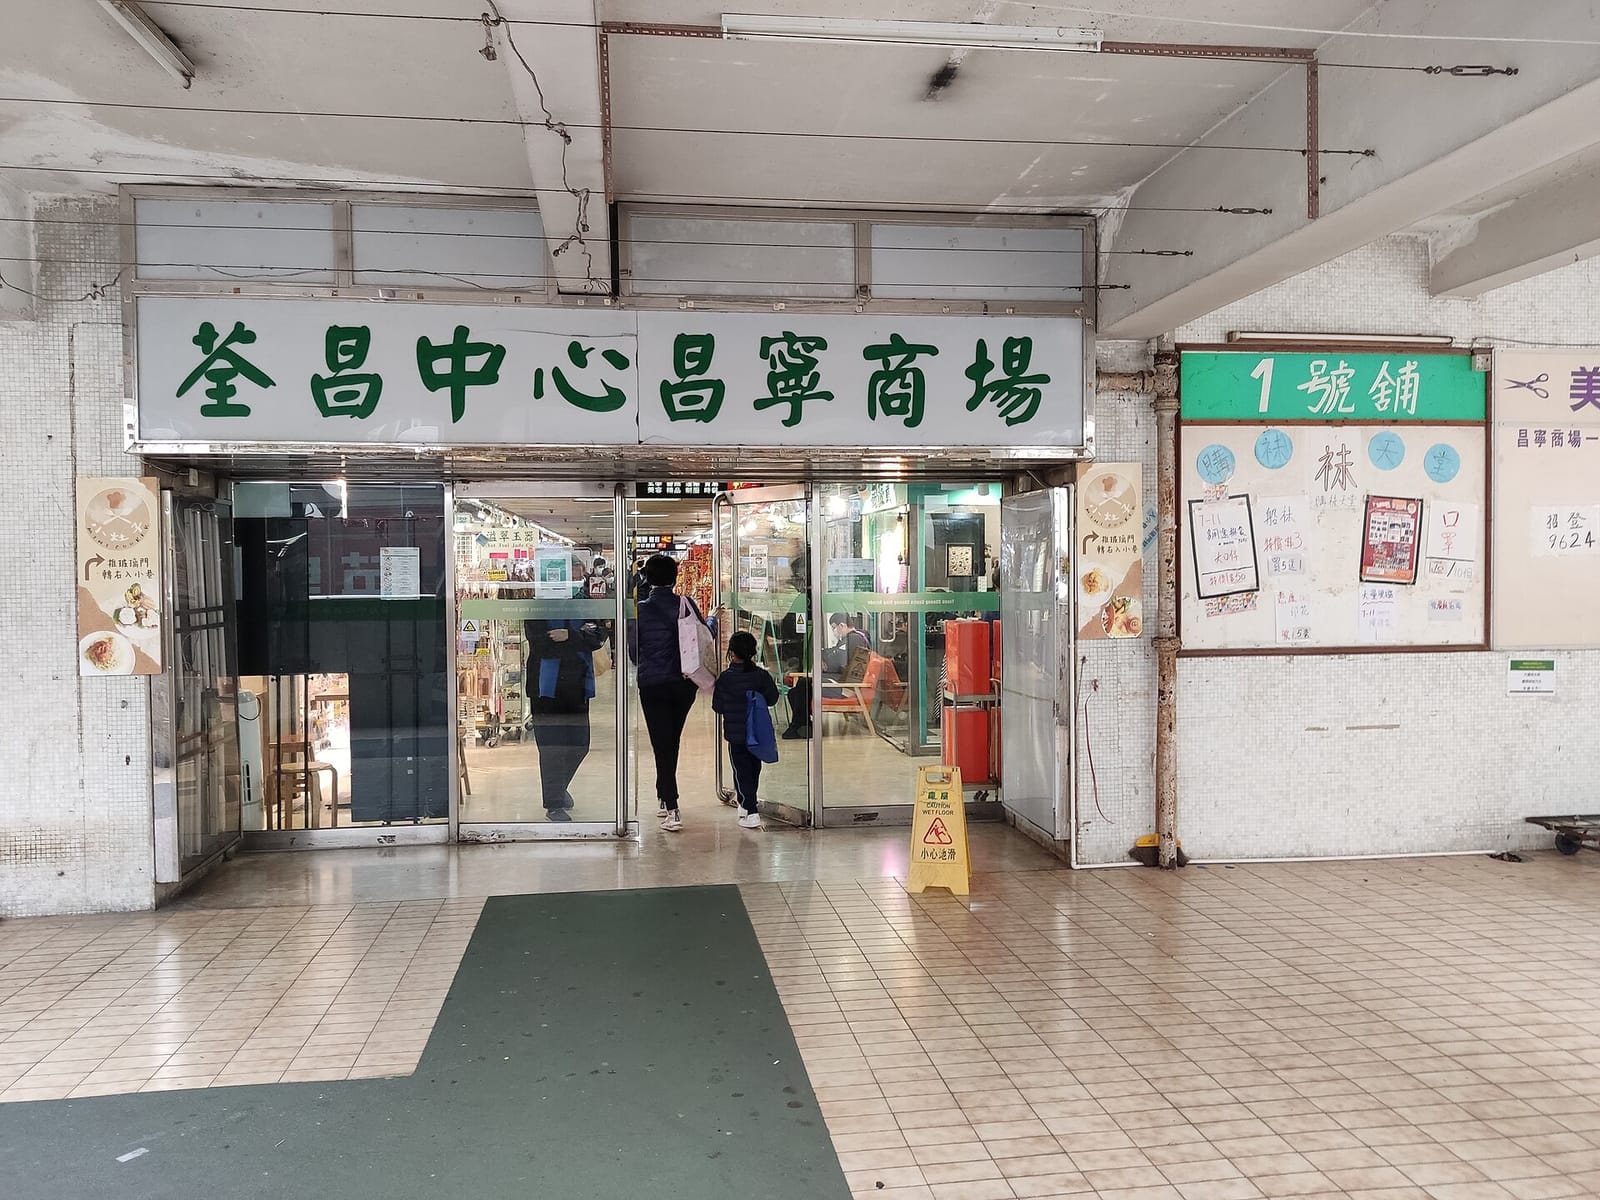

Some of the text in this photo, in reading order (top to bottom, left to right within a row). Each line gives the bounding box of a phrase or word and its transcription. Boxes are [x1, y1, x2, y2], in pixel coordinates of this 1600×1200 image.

[176, 322, 1051, 428] 荃昌中心昌寧商場
[1569, 366, 1600, 412] 美
[1517, 428, 1599, 448] 昌寧商場一
[1548, 530, 1596, 550] 9624
[926, 801, 951, 809] CAUTION
[920, 847, 957, 861] 小心地滑
